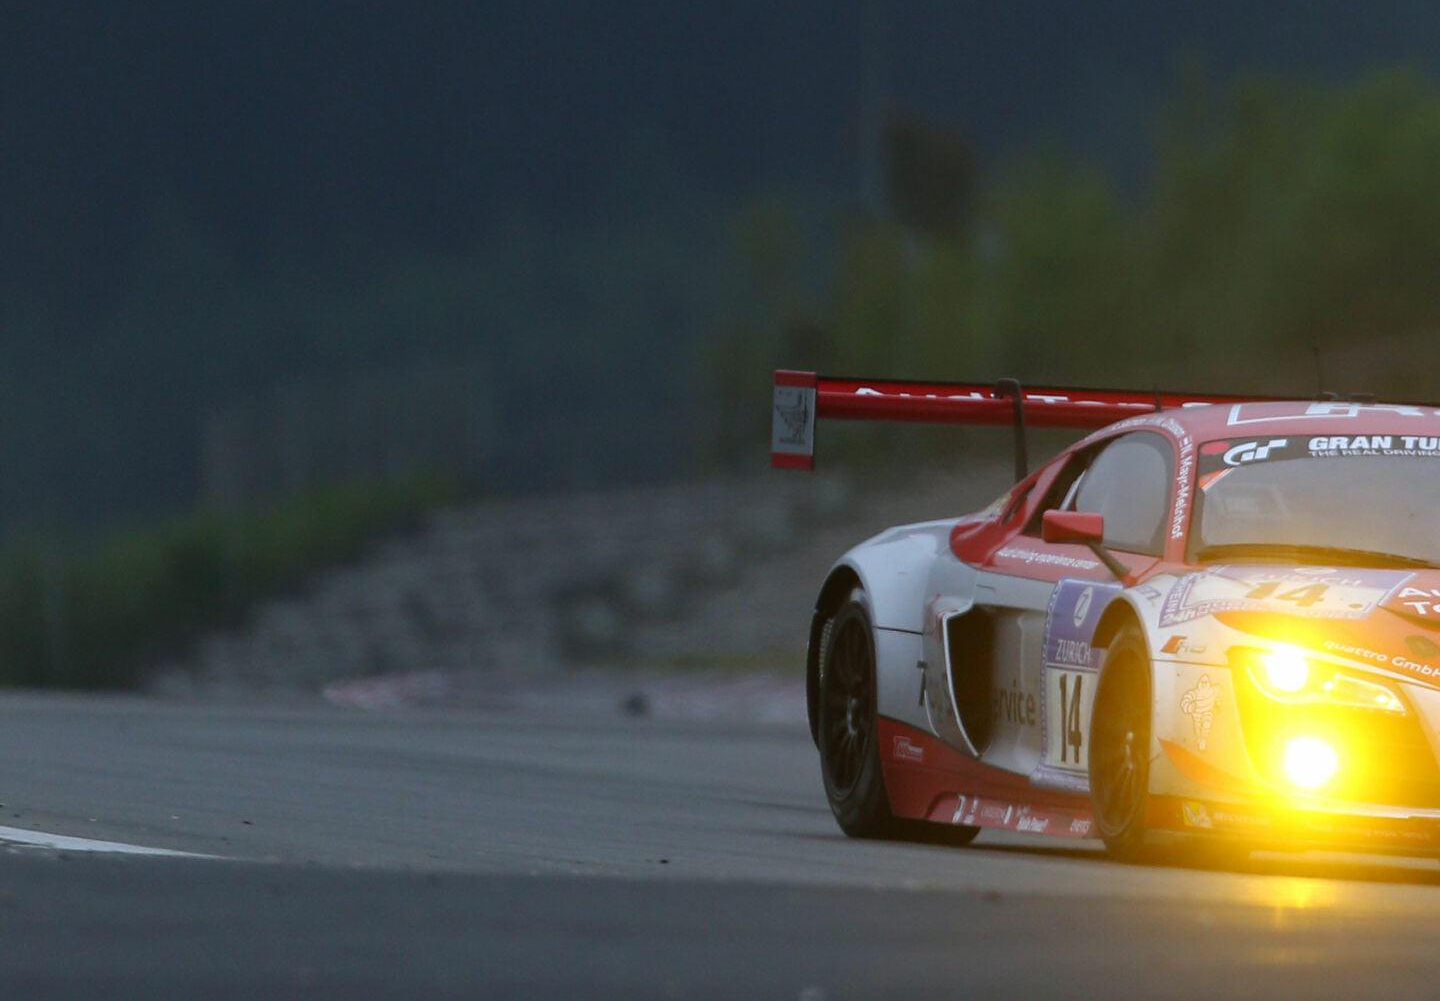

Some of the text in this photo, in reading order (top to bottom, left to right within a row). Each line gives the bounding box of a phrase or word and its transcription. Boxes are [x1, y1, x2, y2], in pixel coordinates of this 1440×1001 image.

[1308, 435, 1393, 451] GRAN
[1308, 450, 1338, 458] THE
[1341, 448, 1380, 457] REAL
[1245, 581, 1331, 608] 14
[1055, 638, 1092, 665] ZURICH
[1323, 639, 1389, 663] quattro
[1059, 673, 1083, 764] 14
